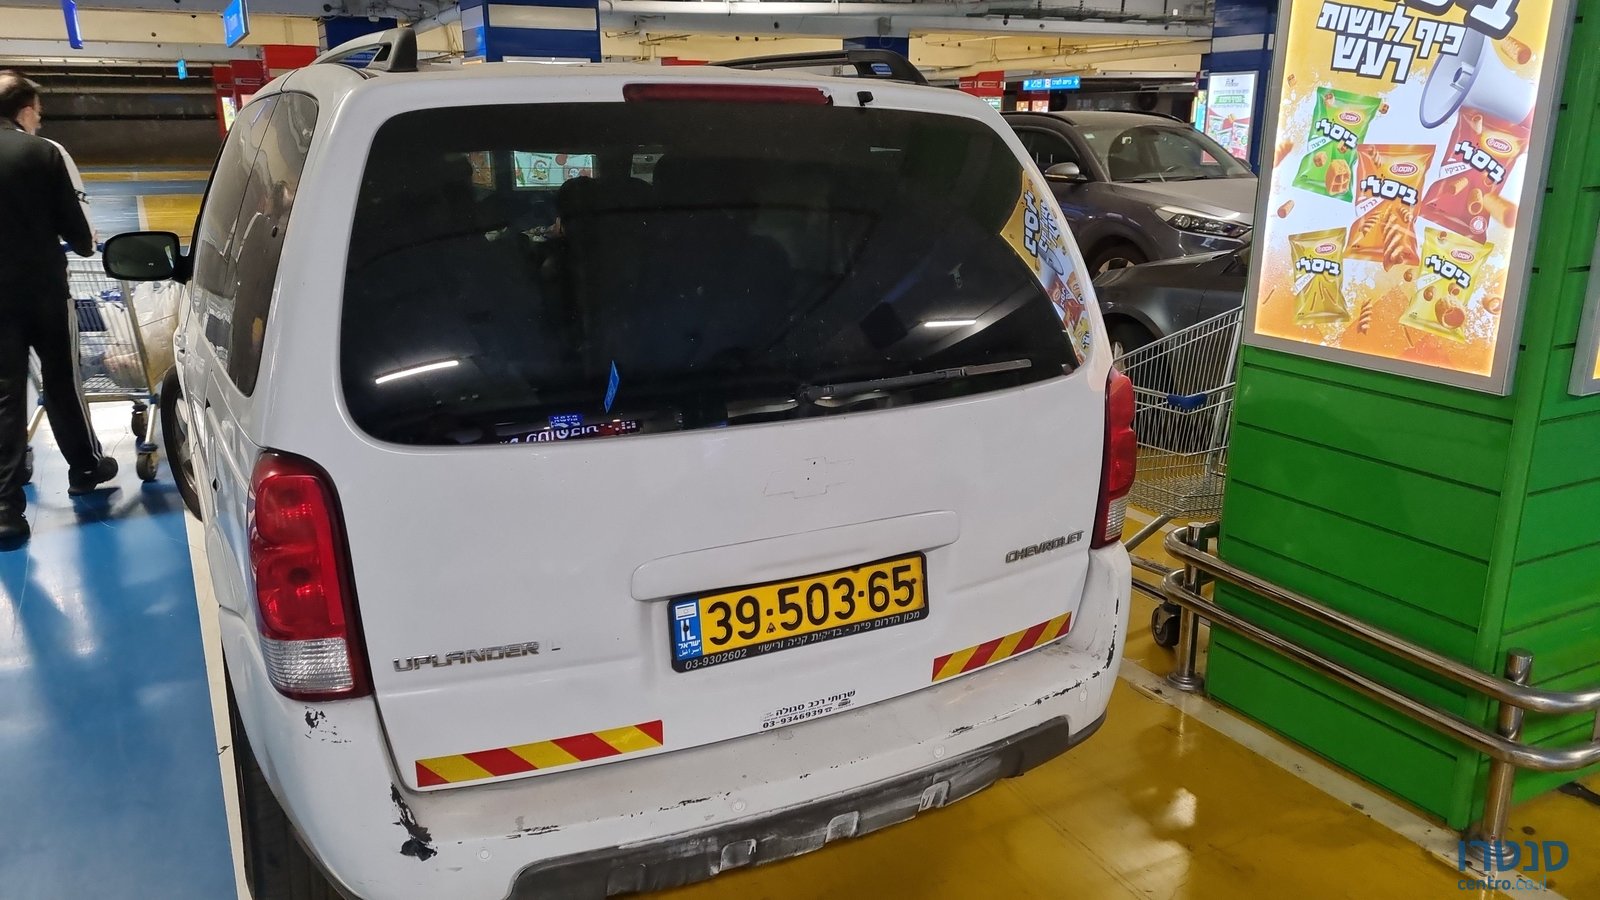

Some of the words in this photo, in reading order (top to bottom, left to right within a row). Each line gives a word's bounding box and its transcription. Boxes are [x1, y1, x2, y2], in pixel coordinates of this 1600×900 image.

[1316, 2, 1414, 42] לעשות
[1413, 18, 1467, 59] כיף
[1331, 34, 1416, 83] רעש
[1315, 118, 1358, 149] ביסלי
[1454, 141, 1506, 184] ביסלי
[1360, 175, 1418, 206] ביסלי
[1360, 198, 1379, 211] גריל
[1295, 257, 1341, 276] ביסלי
[1425, 254, 1472, 289] ביסלי
[1005, 530, 1084, 563] CHEVROLET
[874, 615, 901, 628] הדרום
[903, 611, 920, 623] מכון
[680, 619, 697, 642] IL
[787, 635, 808, 647] קניה
[678, 640, 701, 650] ישראל
[758, 641, 784, 653] ורישוי
[392, 641, 540, 672] UPLANDER
[685, 648, 747, 670] 03-9302602
[808, 698, 825, 708] רכב
[827, 690, 856, 702] שרותי
[763, 708, 823, 728] 03-9346939
[776, 704, 805, 716] סגולה
